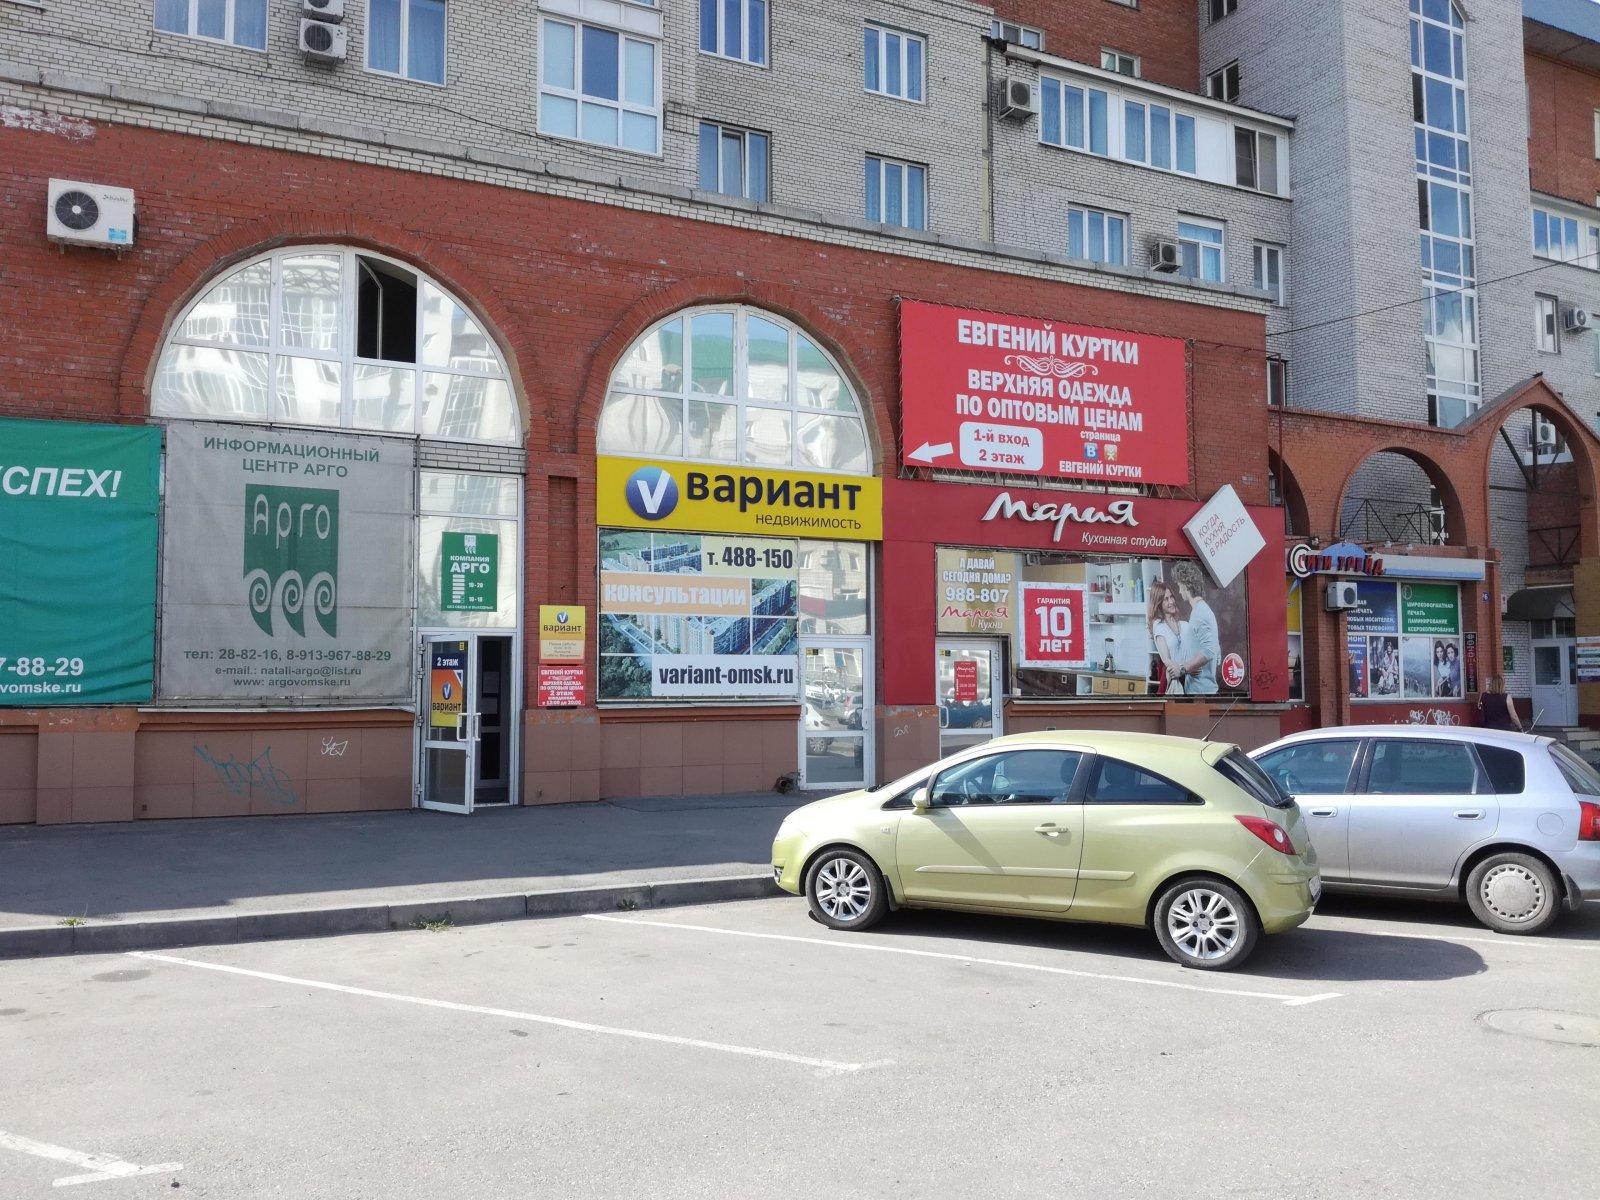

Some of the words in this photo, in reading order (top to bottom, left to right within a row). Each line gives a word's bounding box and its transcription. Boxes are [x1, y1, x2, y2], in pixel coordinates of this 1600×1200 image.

[958, 319, 1056, 354] ЕВГЕНИЙ
[1062, 332, 1139, 365] КУРТКИ
[968, 369, 1054, 398] ВЕРХНЯЯ
[1058, 379, 1132, 408] ОДЕЖДА
[956, 394, 983, 416] ПО
[987, 397, 1079, 426] ОПТОВЫМ
[1084, 408, 1143, 432] ЦЕНАМ
[974, 428, 994, 444] 1-й
[998, 433, 1030, 447] вход
[1080, 430, 1121, 443] страница
[203, 436, 380, 462] ИНФОРМАЦИОННЫЙ
[979, 449, 987, 461] 2
[991, 452, 1025, 464] этаж
[242, 458, 299, 474] ЦЕНТР
[304, 465, 348, 478] АРГО
[1059, 460, 1104, 474] ЕВГЕНИЙ
[1105, 464, 1142, 478] КУРТКИ
[0, 465, 122, 498] СПЕХ!
[687, 471, 862, 512] вариант
[253, 493, 331, 550] Арго
[755, 513, 862, 530] недвижимость
[1197, 513, 1220, 538] КОГДА
[1081, 531, 1127, 546] Кухонная
[1130, 535, 1168, 549] студия
[1203, 522, 1226, 548] КУХНЯ
[1214, 517, 1246, 552] РАДОСТЬ
[450, 555, 490, 563] КОМПАНИЯ
[707, 551, 719, 565] т.
[721, 546, 793, 569] 488-150
[959, 557, 966, 569] А
[966, 557, 995, 570] ДАВАЙ
[450, 561, 490, 574] АРГО
[943, 570, 980, 583] СЕГОДНЯ
[982, 571, 1011, 585] ДОМА?
[945, 587, 1009, 603] 988-807
[1036, 597, 1071, 605] ГАРАНТИЯ
[543, 624, 582, 633] вариант
[1034, 605, 1072, 637] 10
[184, 650, 214, 660] тел:
[218, 648, 282, 662] 28-82-16,
[286, 649, 392, 662] 8-913-967-88-29
[1038, 639, 1073, 653] лет
[437, 657, 442, 666] 2
[442, 658, 459, 667] этаж
[260, 666, 362, 678] natali-argo@list.ru
[659, 665, 794, 685] variant-omsk.ru
[233, 679, 264, 687] www:
[268, 678, 351, 688] argovomske.ru
[432, 702, 462, 714] вариант
